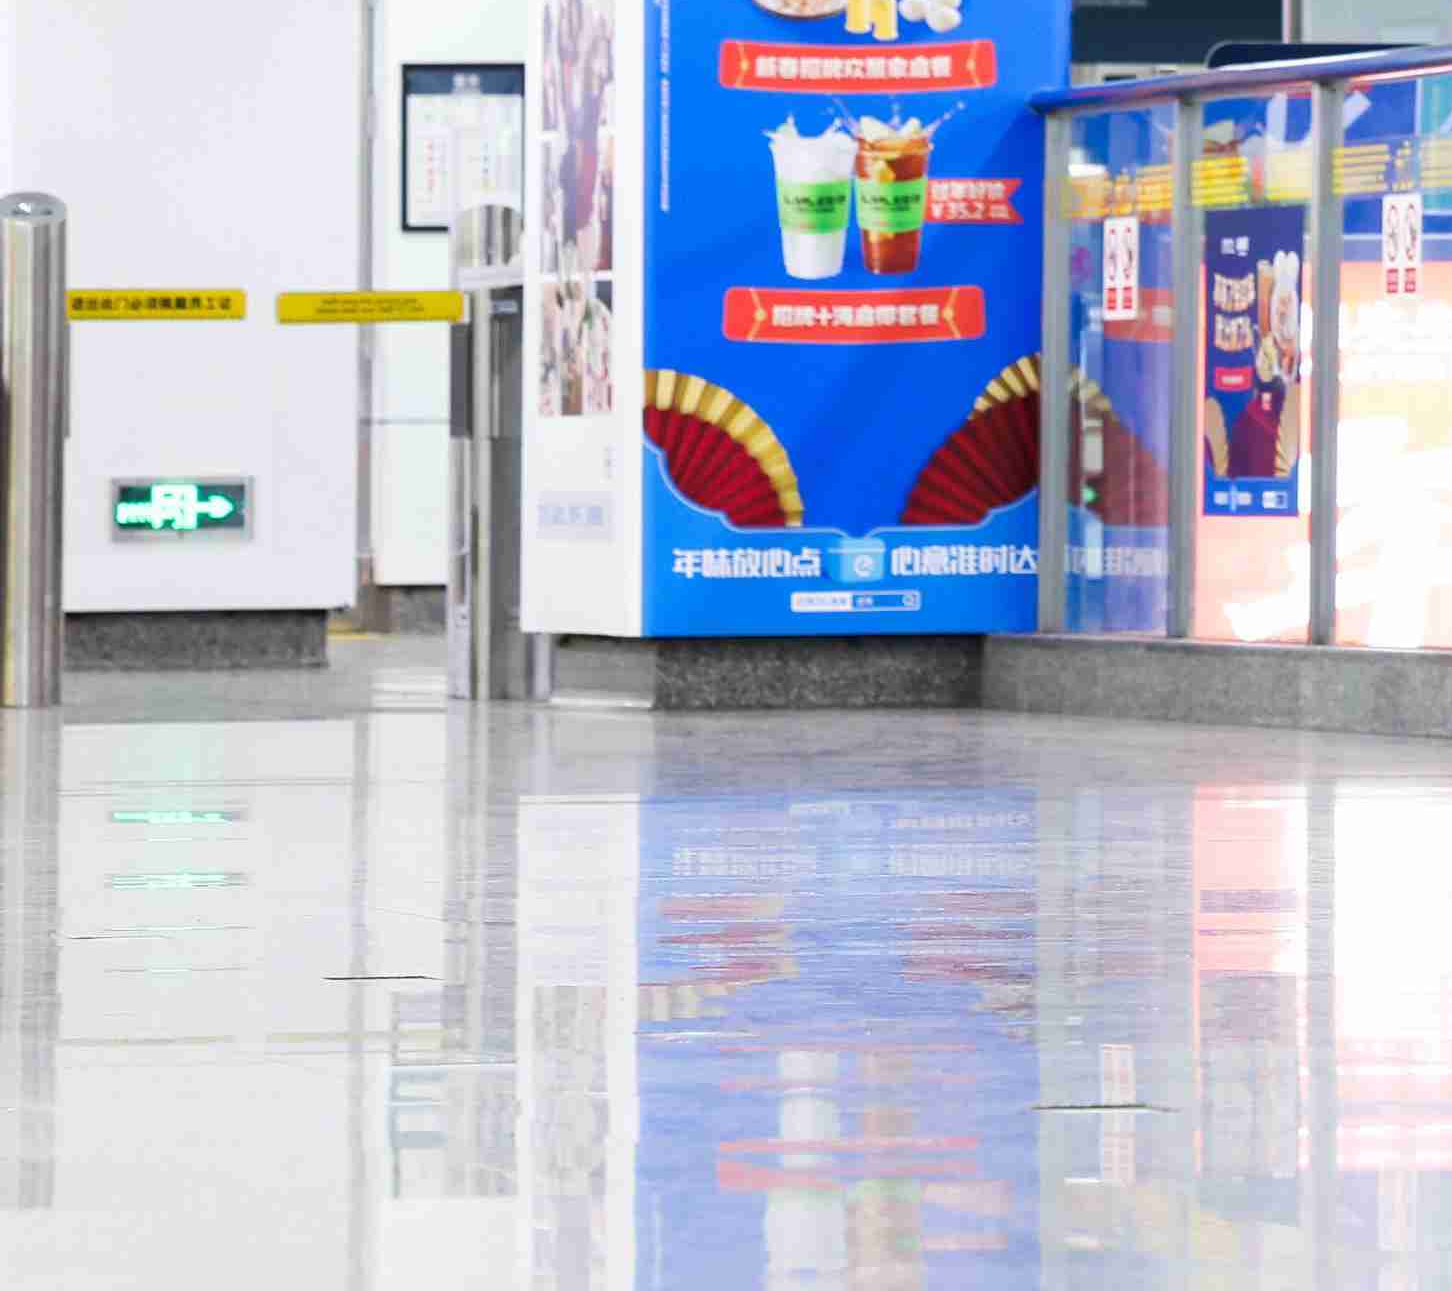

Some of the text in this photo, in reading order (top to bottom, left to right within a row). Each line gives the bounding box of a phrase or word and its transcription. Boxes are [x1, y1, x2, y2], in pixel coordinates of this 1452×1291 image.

[671, 546, 822, 579] 年味放心点
